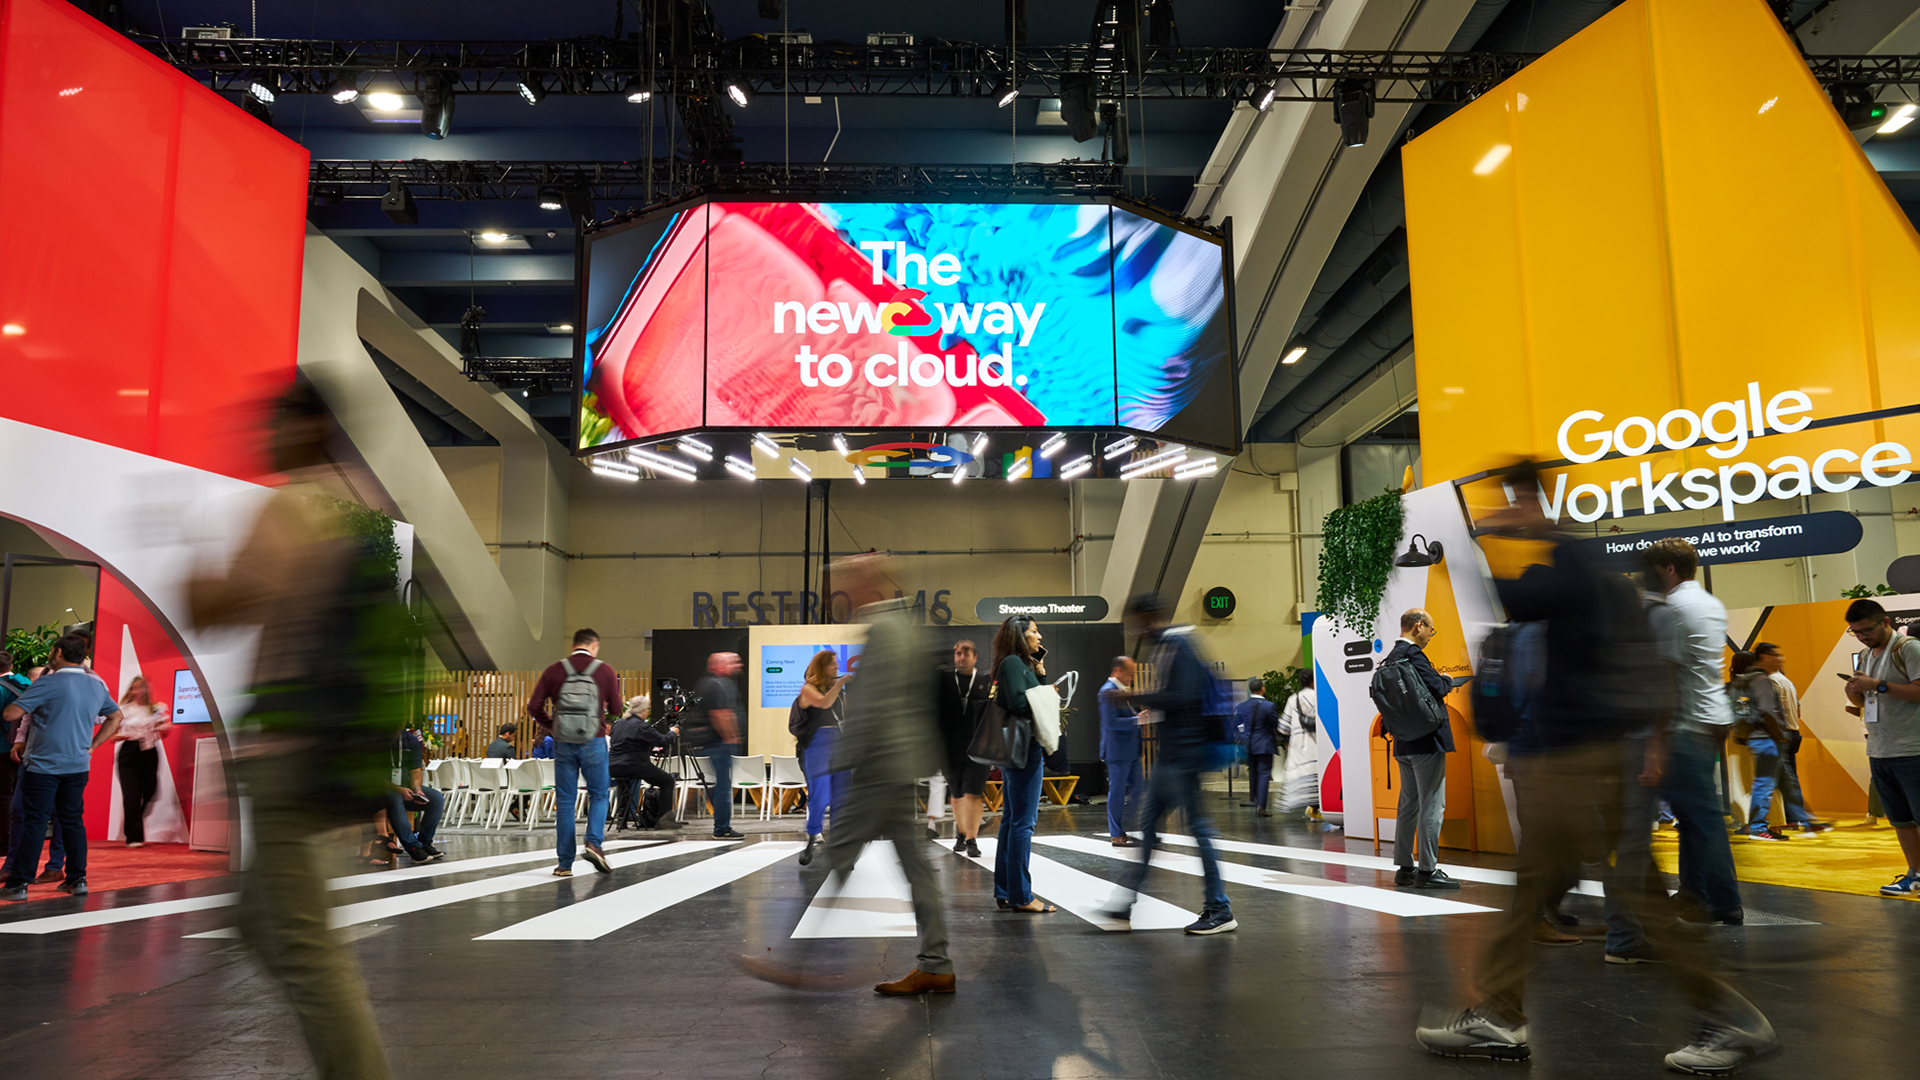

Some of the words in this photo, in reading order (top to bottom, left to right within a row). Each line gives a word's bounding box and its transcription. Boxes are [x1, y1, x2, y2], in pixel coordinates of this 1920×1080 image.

[860, 240, 961, 286] The
[774, 301, 889, 335] new
[933, 301, 1047, 347] way
[795, 345, 853, 387] to
[864, 341, 1028, 387] cloud.
[1557, 381, 1813, 459] Google
[1606, 541, 1635, 554] How
[1701, 531, 1715, 544] AI
[1717, 530, 1732, 542] to
[1734, 523, 1803, 541] transform
[1698, 546, 1718, 558] we
[1719, 540, 1761, 556] work?
[998, 603, 1048, 614] Showcase
[1048, 603, 1086, 613] Theater
[1211, 596, 1229, 609] EXIT
